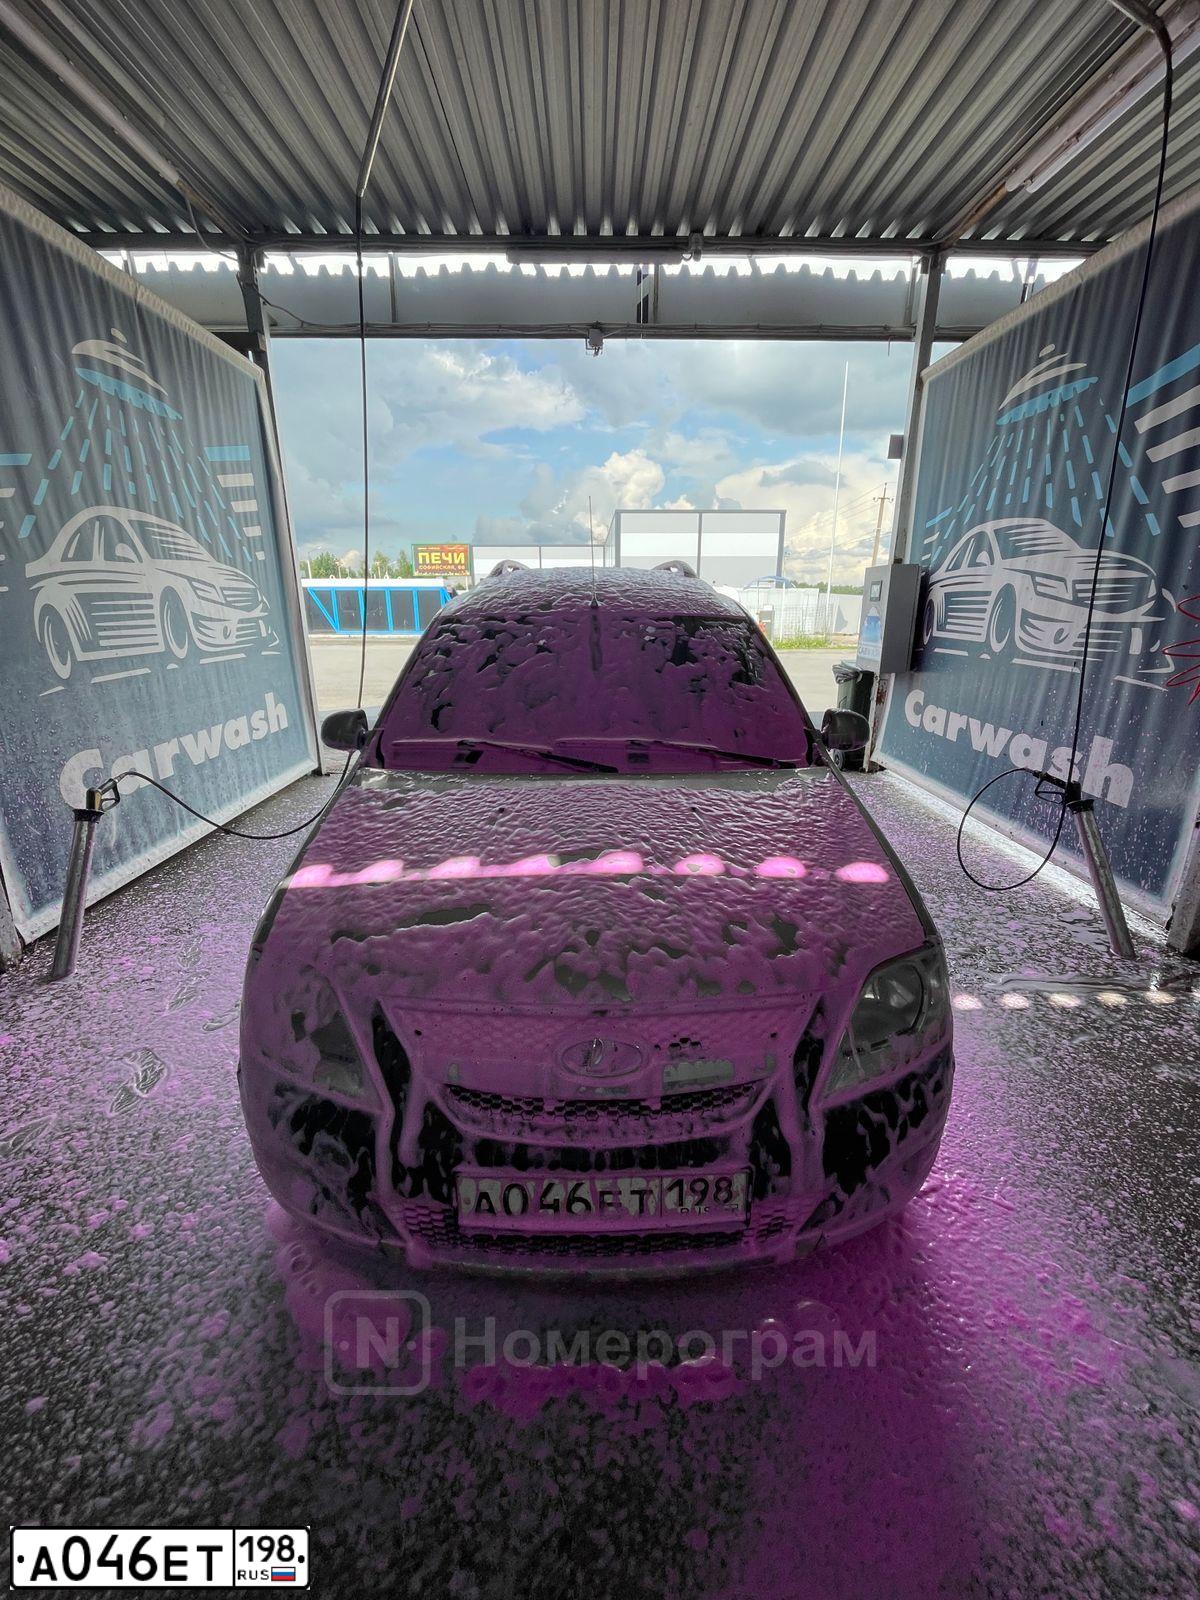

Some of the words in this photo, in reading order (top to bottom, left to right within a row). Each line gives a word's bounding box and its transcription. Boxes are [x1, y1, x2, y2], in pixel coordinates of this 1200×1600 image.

[418, 552, 464, 564] ПЕЧИ
[59, 692, 288, 810] Carwash
[904, 689, 1134, 808] Carwash
[666, 1176, 734, 1207] 198
